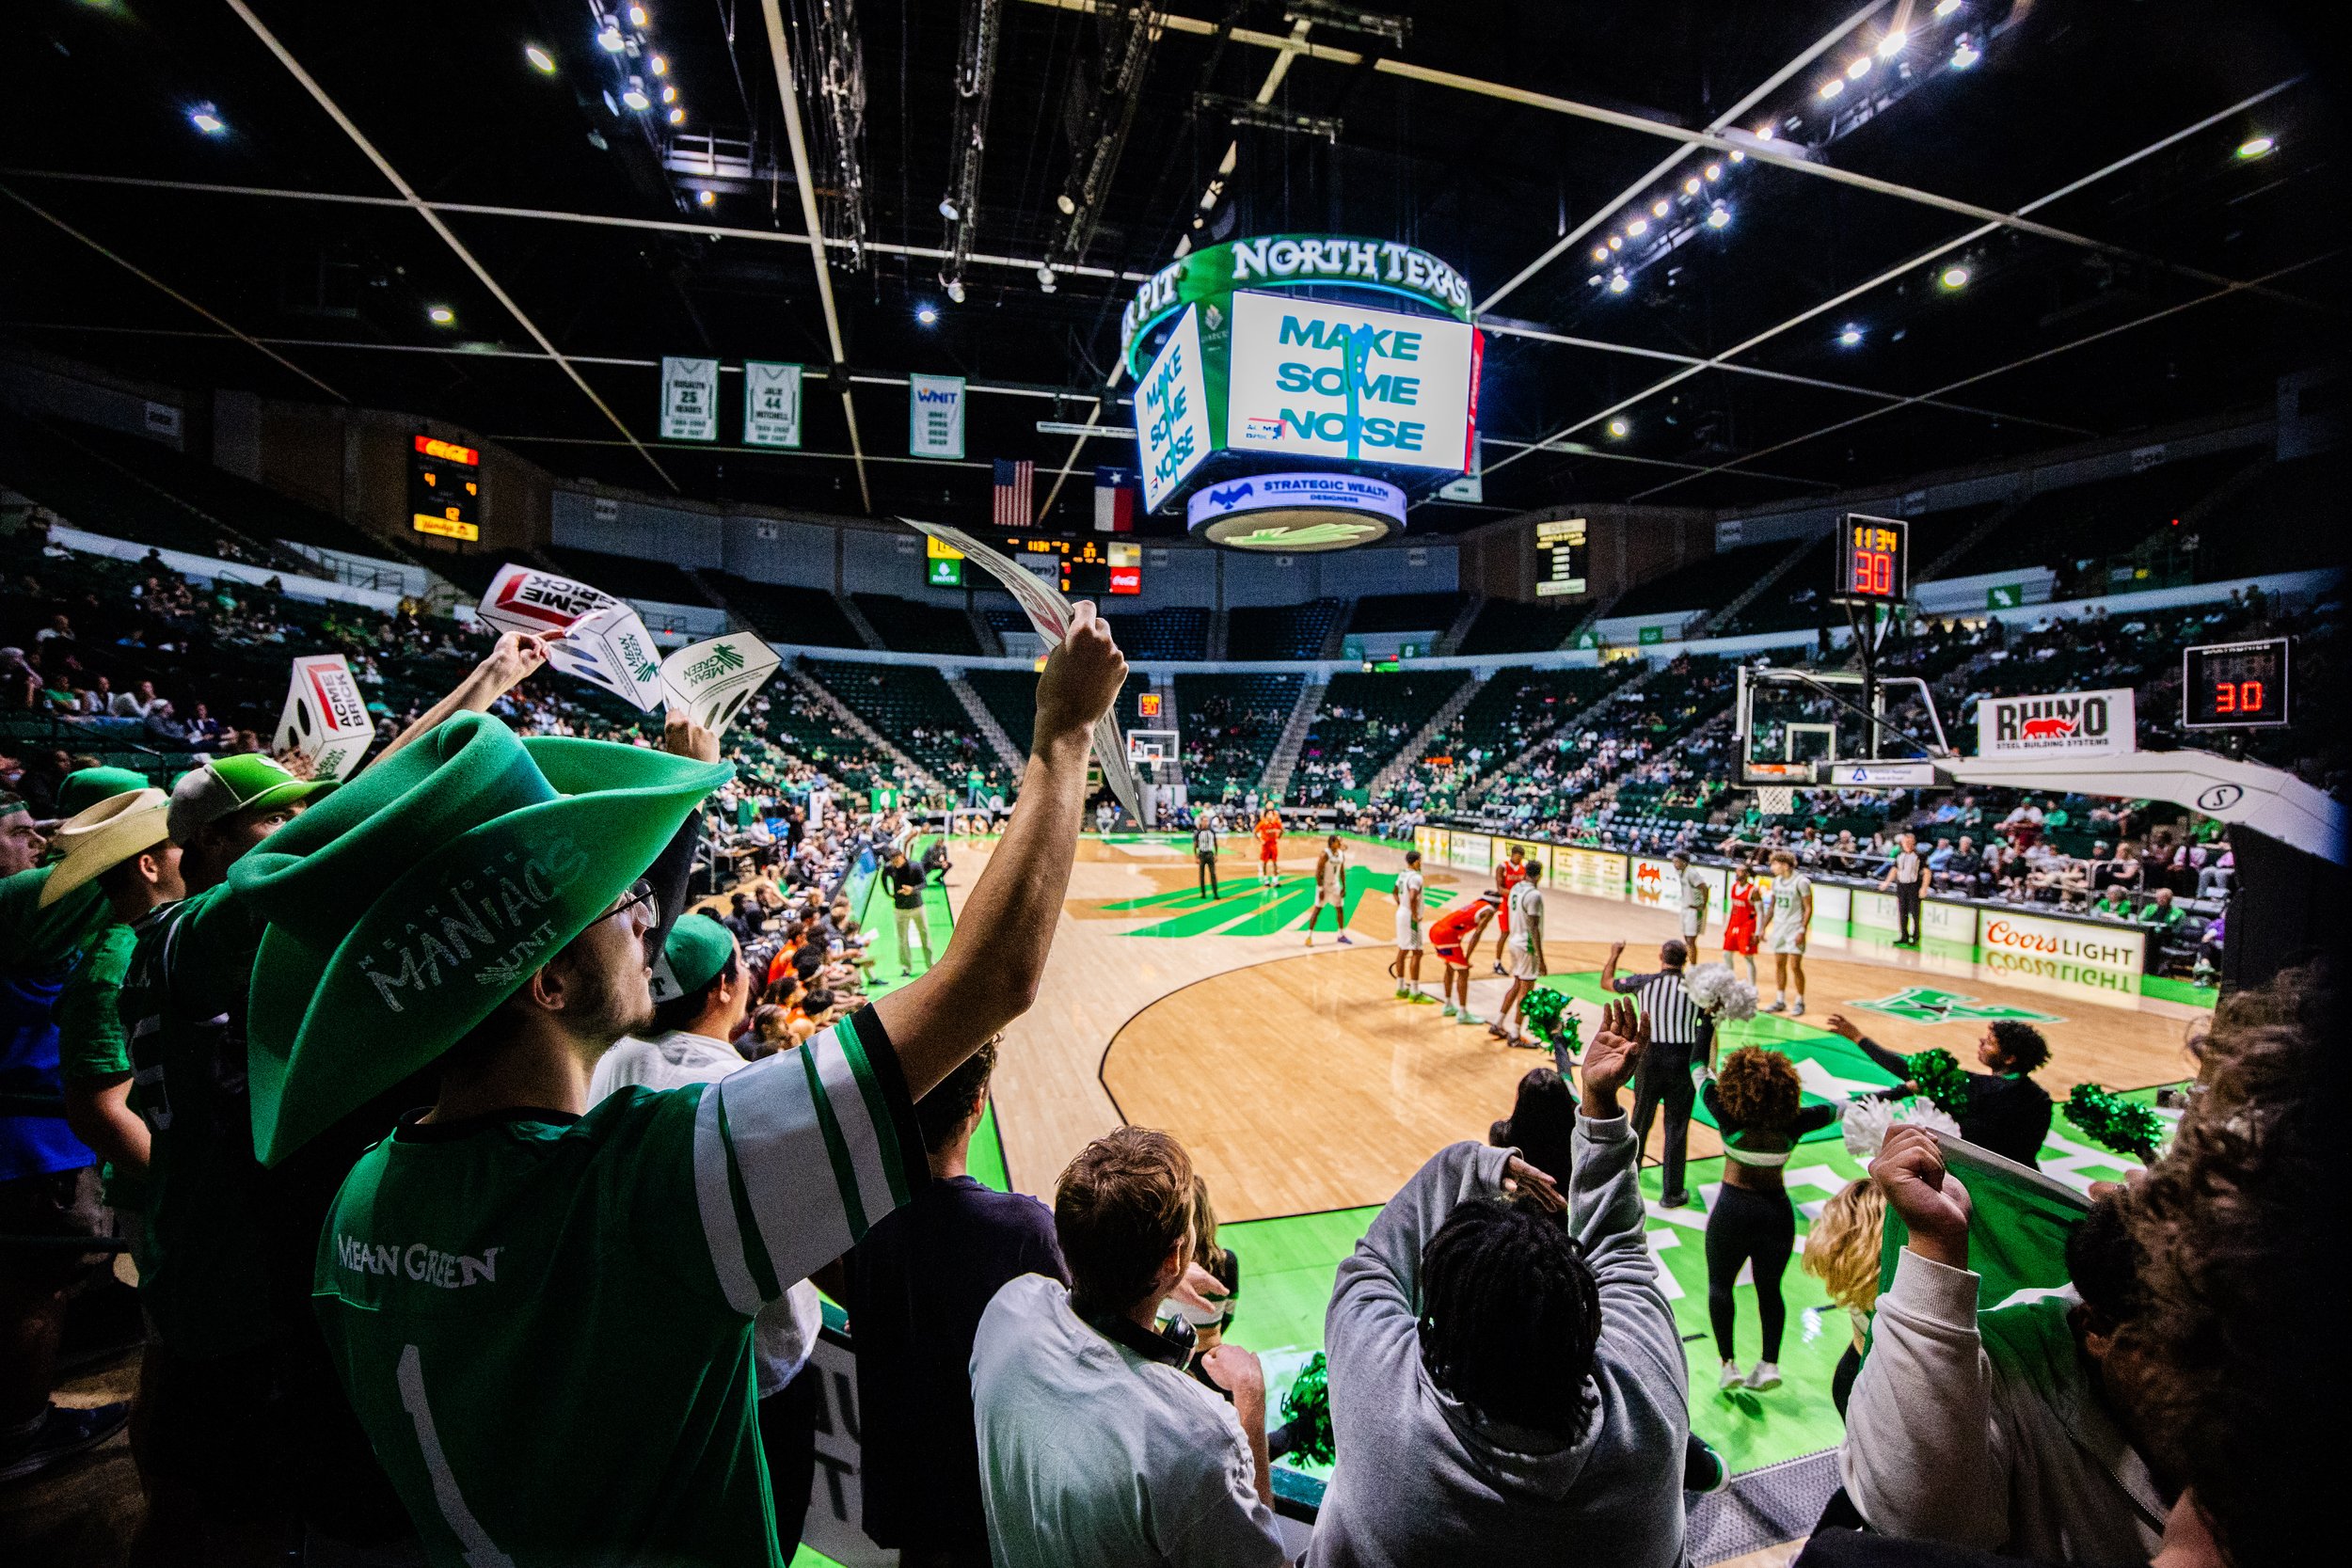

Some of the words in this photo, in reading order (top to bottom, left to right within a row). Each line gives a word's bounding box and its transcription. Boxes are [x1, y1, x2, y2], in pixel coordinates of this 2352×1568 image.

[1138, 262, 1181, 321] PIT
[1232, 237, 1379, 280] NORTH
[1380, 242, 1467, 306] TEXAS
[1279, 315, 1422, 361] MAKE
[917, 389, 958, 404] WNIT
[1146, 344, 1182, 414] MAKE
[1276, 362, 1421, 405] SOME
[764, 397, 781, 409] 44
[1151, 386, 1187, 451] SOME
[1263, 480, 1344, 491] STRATEGIC
[1347, 483, 1390, 498] WEALTH
[1310, 494, 1359, 503] DESIGNERS
[1855, 550, 1891, 594] 30
[618, 636, 641, 668] MEAN
[626, 632, 650, 670] GREEN
[683, 655, 722, 680] GREEN
[691, 665, 724, 688] MEAN
[2216, 681, 2263, 713] 30
[322, 673, 352, 727] ACME
[336, 673, 364, 726] BRICK
[1996, 697, 2107, 740] RHINO
[2068, 738, 2109, 747] SYSTEMS
[2213, 788, 2227, 806] S
[1987, 920, 2058, 954] Coors
[2063, 939, 2134, 965] LIGHT
[338, 1233, 401, 1276] MEAN
[405, 1243, 499, 1289] GREEN
[396, 1344, 516, 1568] 1
